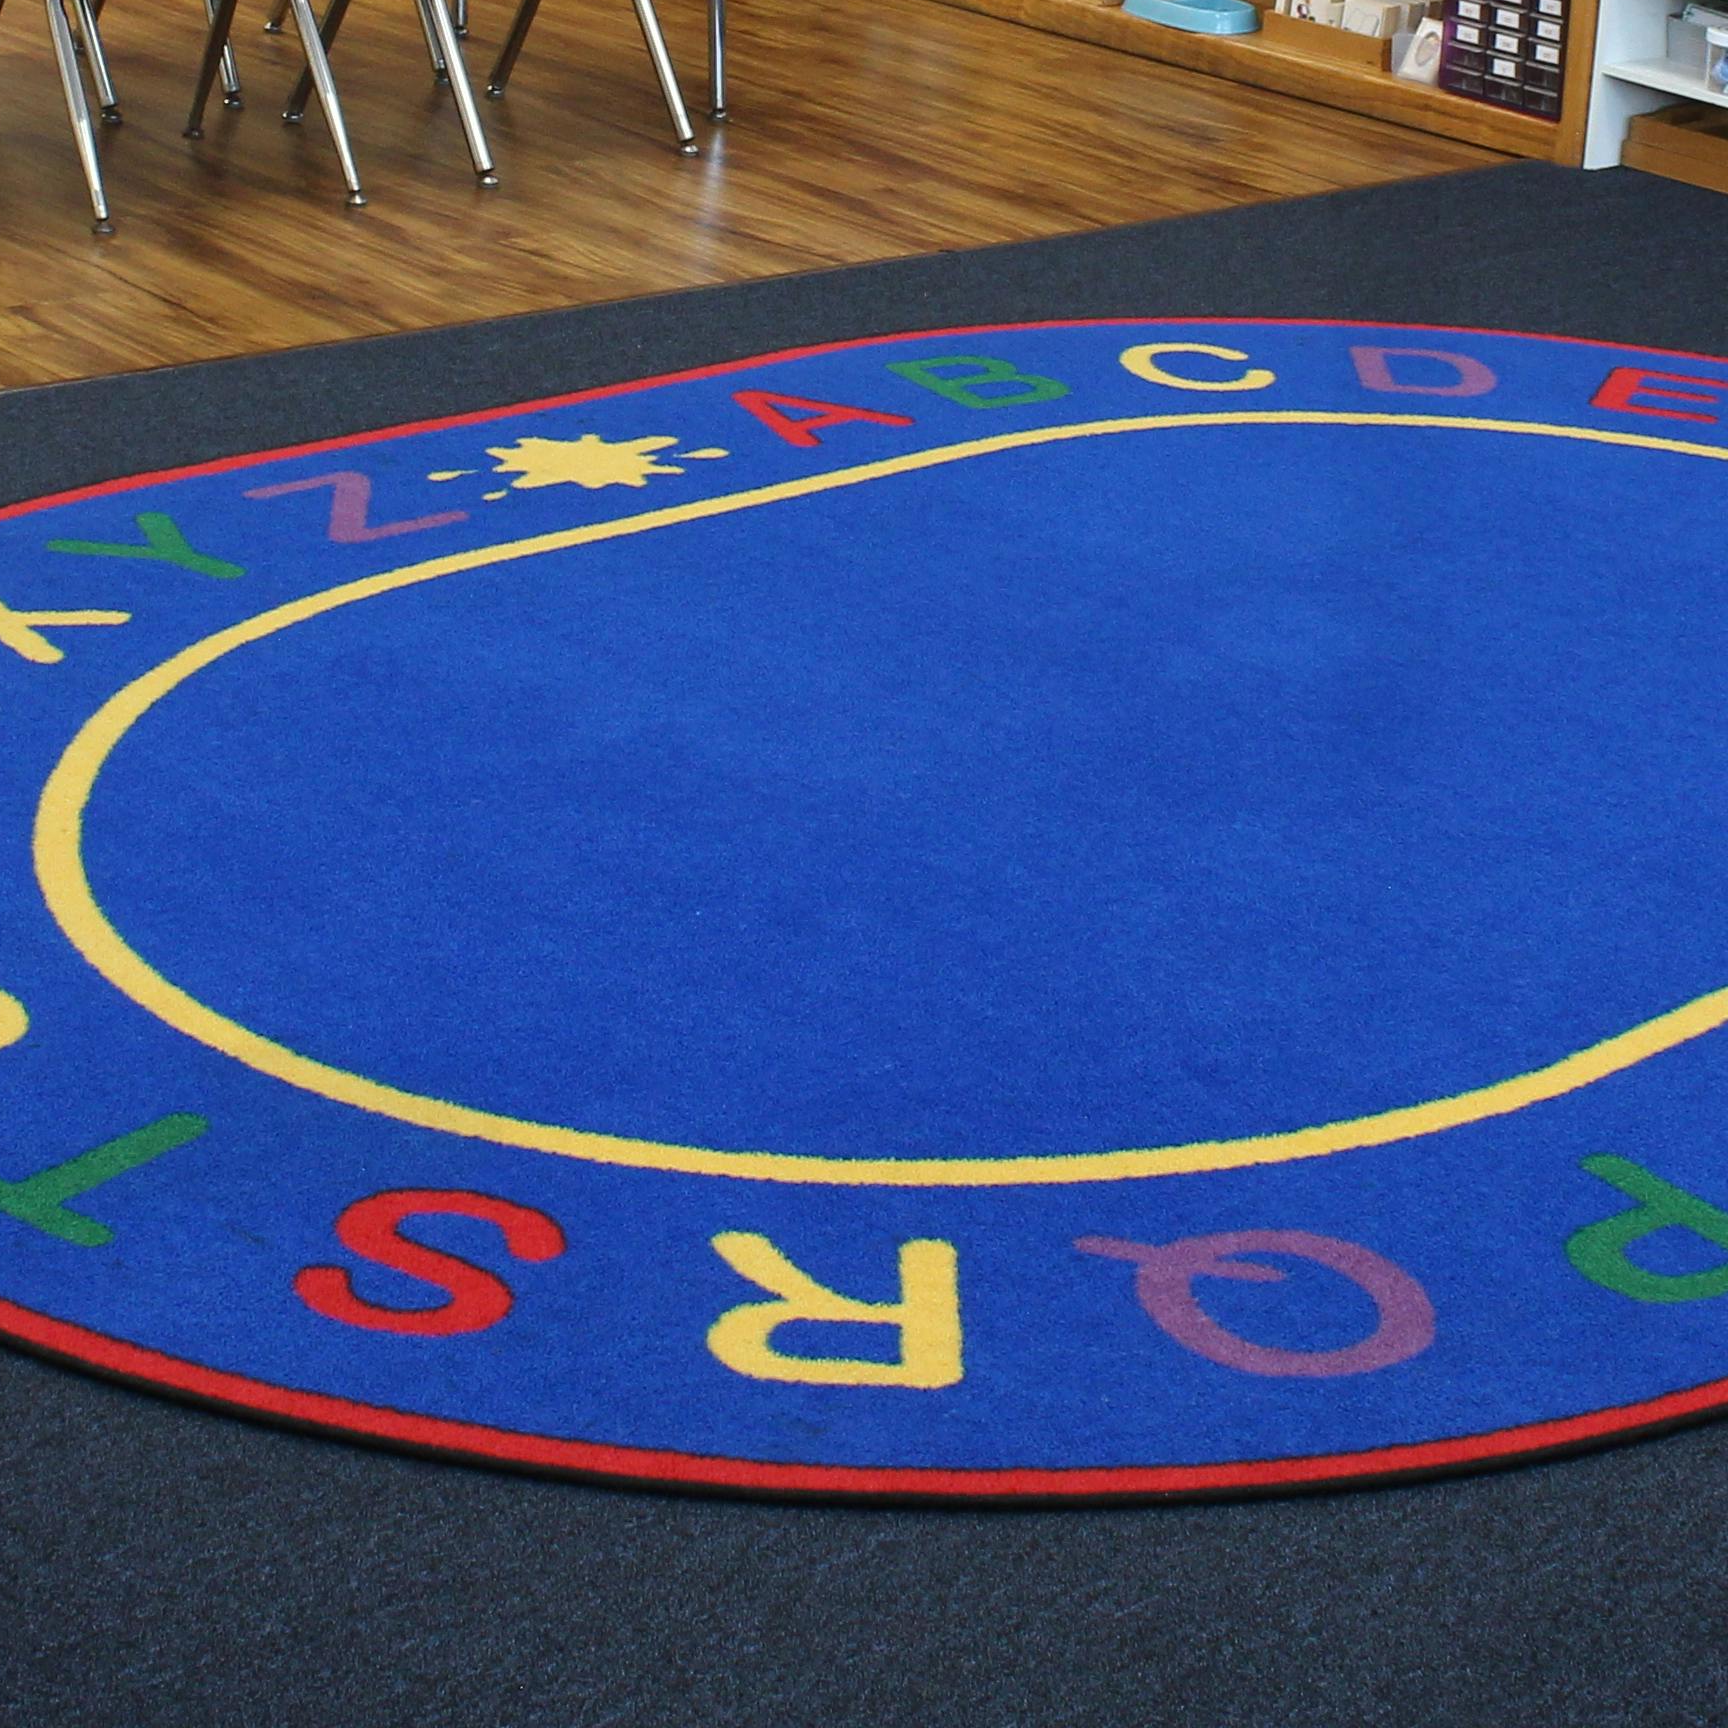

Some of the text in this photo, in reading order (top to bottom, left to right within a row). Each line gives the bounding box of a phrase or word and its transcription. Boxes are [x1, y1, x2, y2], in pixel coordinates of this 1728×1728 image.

[884, 354, 1072, 409] B
[1118, 342, 1277, 392] C
[1349, 345, 1497, 397] D
[730, 388, 916, 448] A
[242, 470, 469, 544] Z
[44, 511, 248, 580] Y
[291, 1188, 567, 1338] S
[704, 1228, 966, 1391] R
[1073, 1229, 1436, 1378] Q
